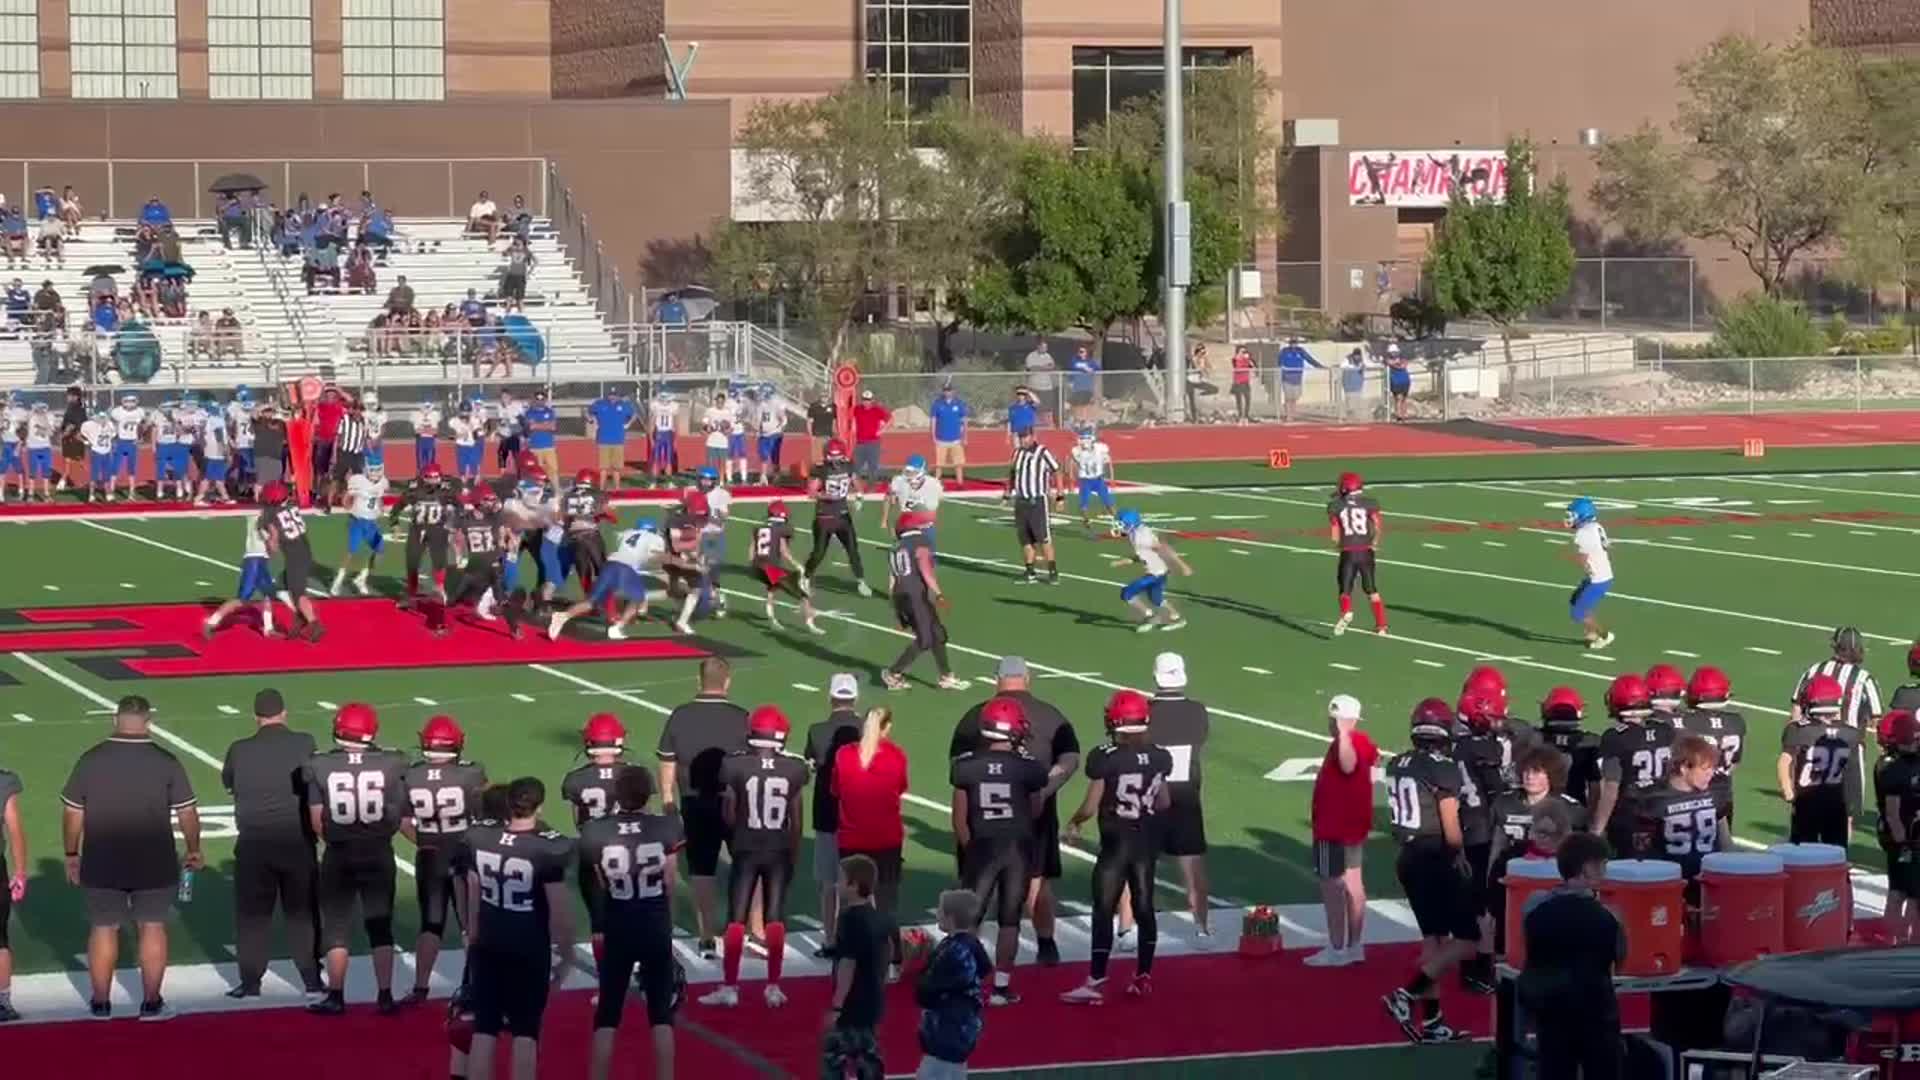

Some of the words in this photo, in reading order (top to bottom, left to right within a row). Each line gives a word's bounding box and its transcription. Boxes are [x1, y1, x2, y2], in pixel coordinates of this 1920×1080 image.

[1272, 450, 1288, 466] 20
[1340, 507, 1367, 536] 18
[624, 530, 640, 548] 4
[757, 528, 772, 556] 2
[1710, 717, 1723, 729] H
[348, 753, 363, 765] H
[1136, 753, 1150, 765] H
[427, 769, 441, 781] H
[600, 768, 613, 779] H
[987, 763, 1003, 775] H
[327, 770, 385, 825] 66
[745, 775, 790, 829] 16
[979, 782, 1014, 820] 5
[409, 786, 468, 834] 22
[617, 822, 641, 835] H
[1664, 808, 1716, 855] 58
[498, 832, 517, 846] H
[601, 842, 667, 900] 82
[476, 849, 535, 912] 52
